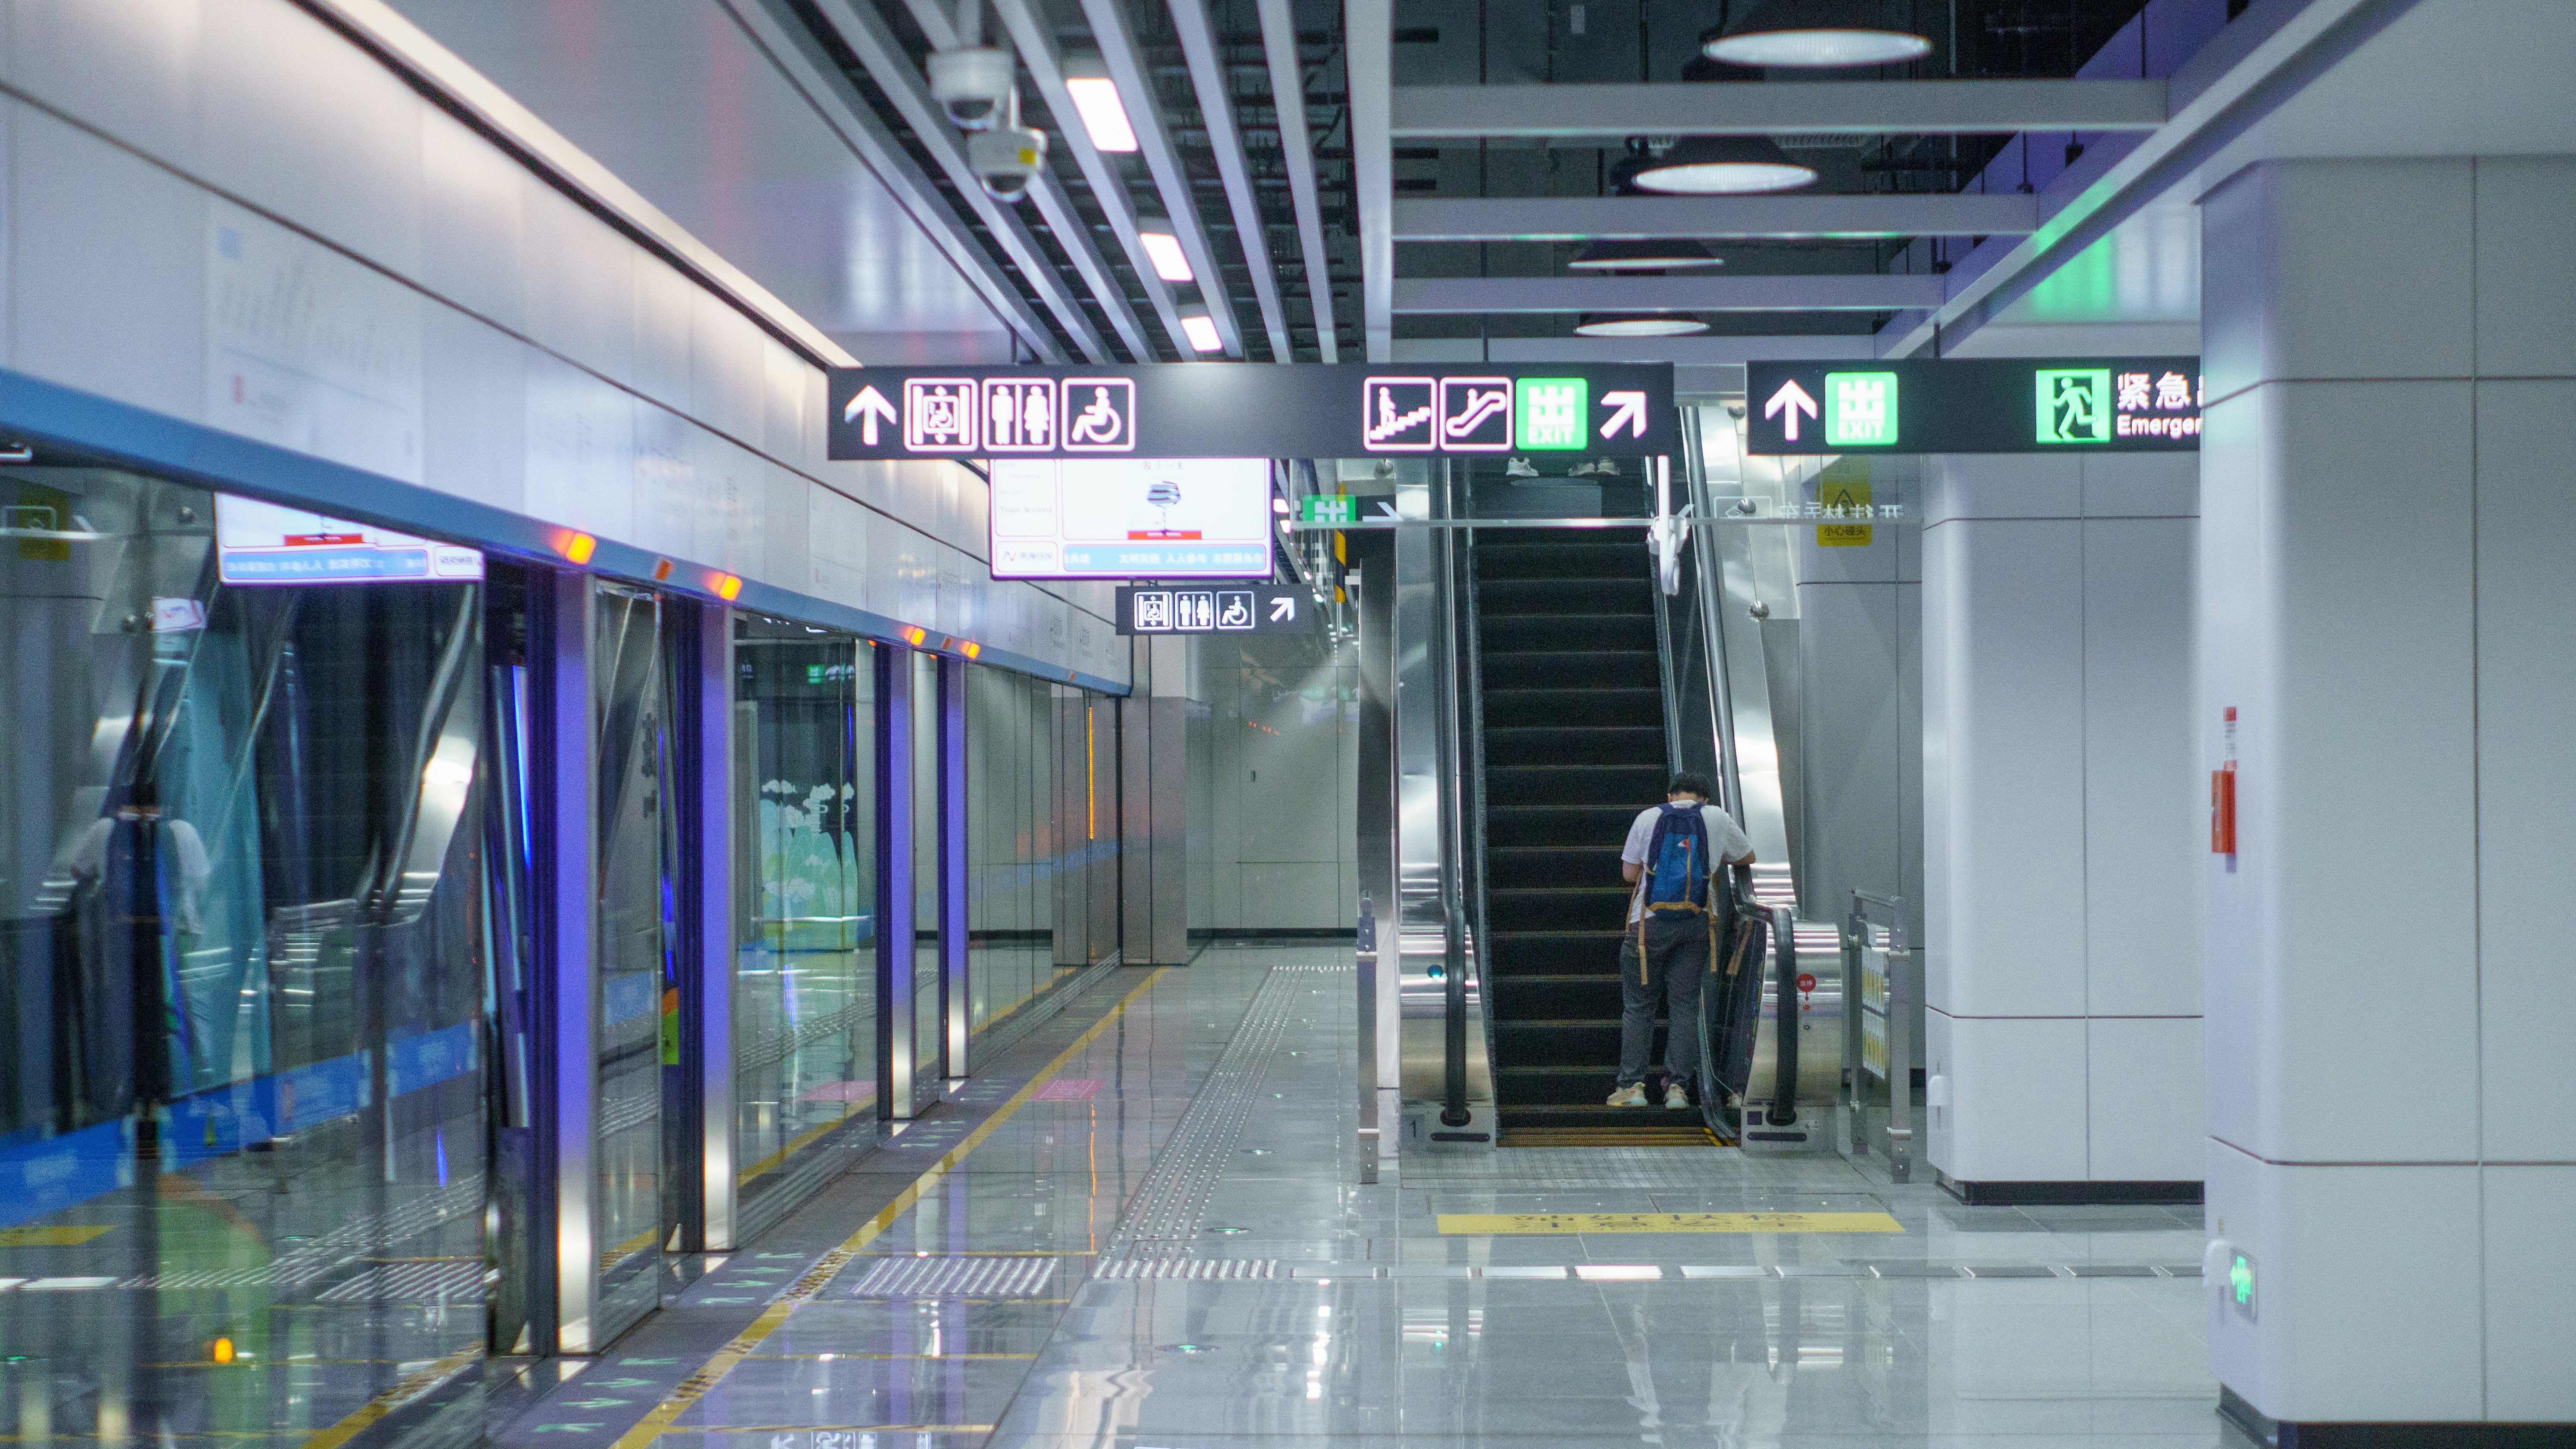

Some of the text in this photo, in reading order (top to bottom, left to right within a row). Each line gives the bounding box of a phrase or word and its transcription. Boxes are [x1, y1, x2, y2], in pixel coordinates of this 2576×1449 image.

[1528, 386, 1575, 425] 出
[1838, 379, 1885, 420] 出
[2117, 371, 2205, 412] 紧急
[1528, 426, 1575, 445] EXIT
[1838, 420, 1885, 439] EXIT
[1409, 1119, 1417, 1138] 1
